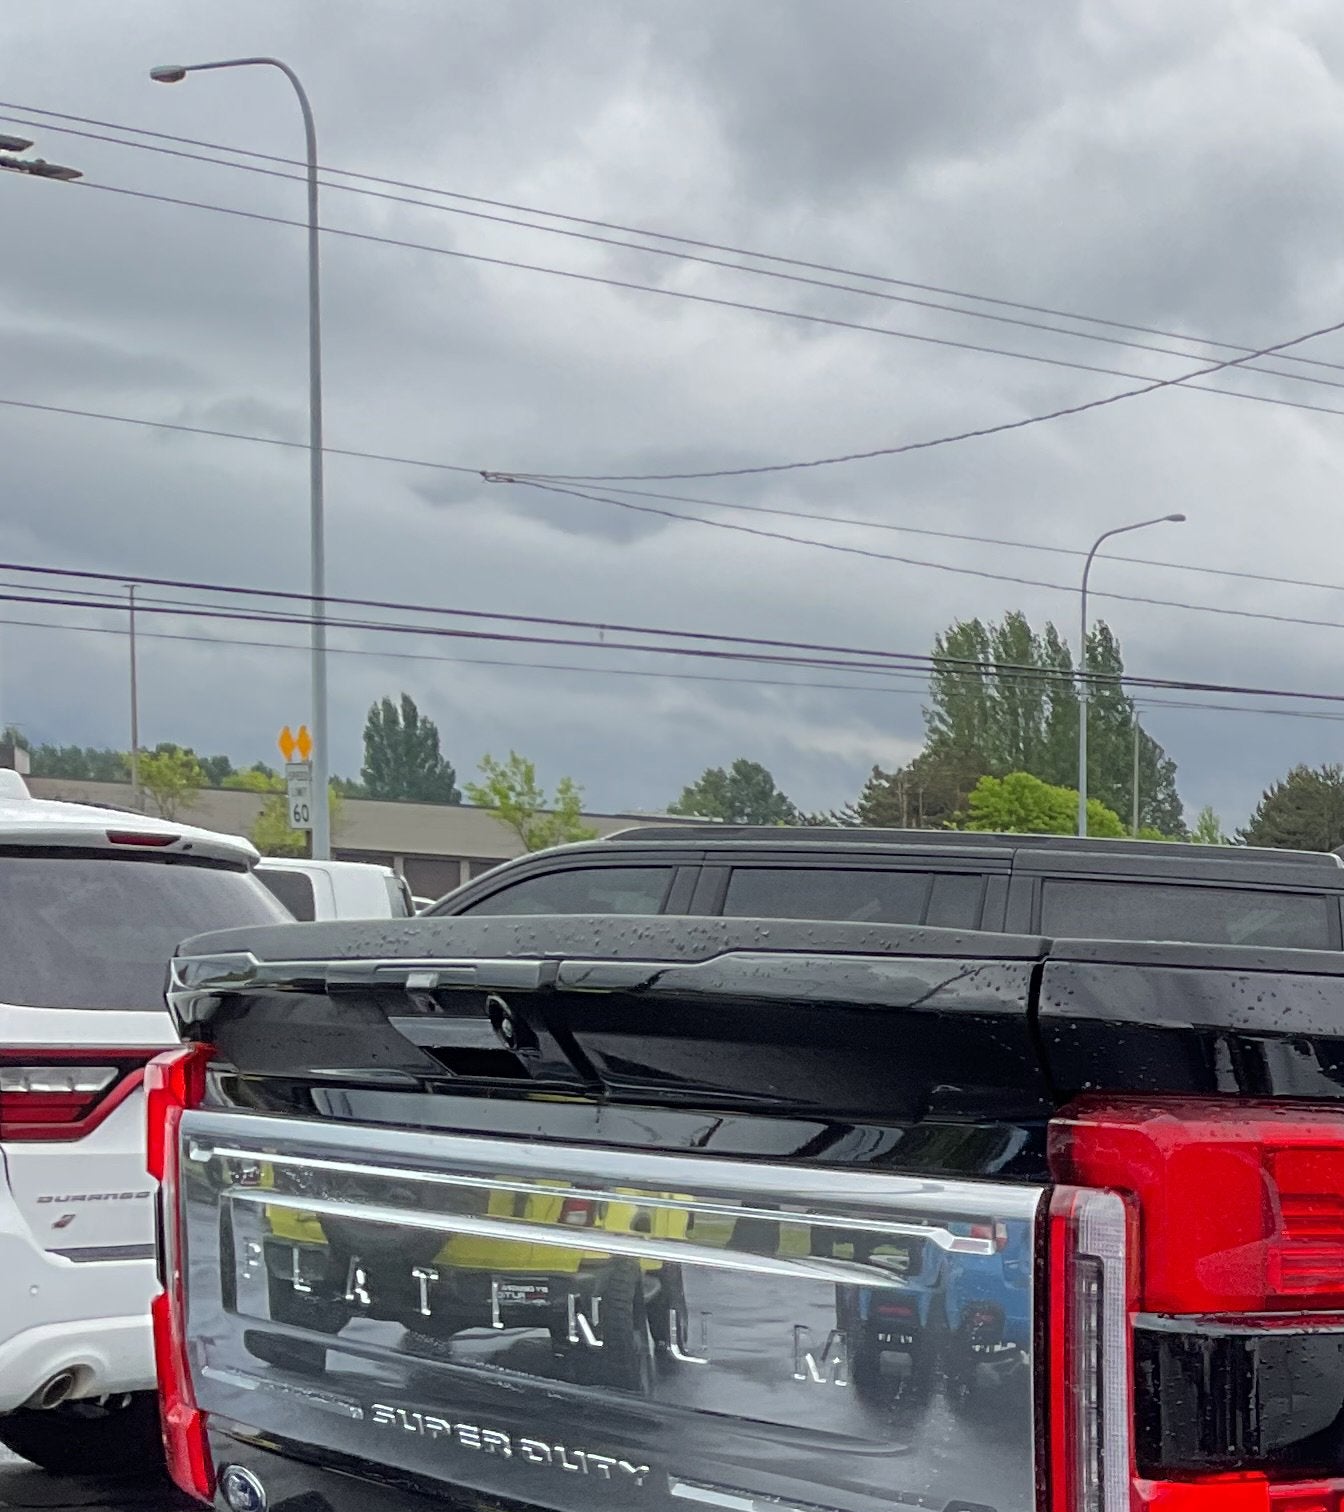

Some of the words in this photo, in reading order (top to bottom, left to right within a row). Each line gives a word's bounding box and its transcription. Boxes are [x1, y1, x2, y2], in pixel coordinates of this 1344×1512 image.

[293, 803, 310, 823] 60
[371, 1402, 513, 1459] SUPER
[519, 1437, 650, 1487] DUTY
